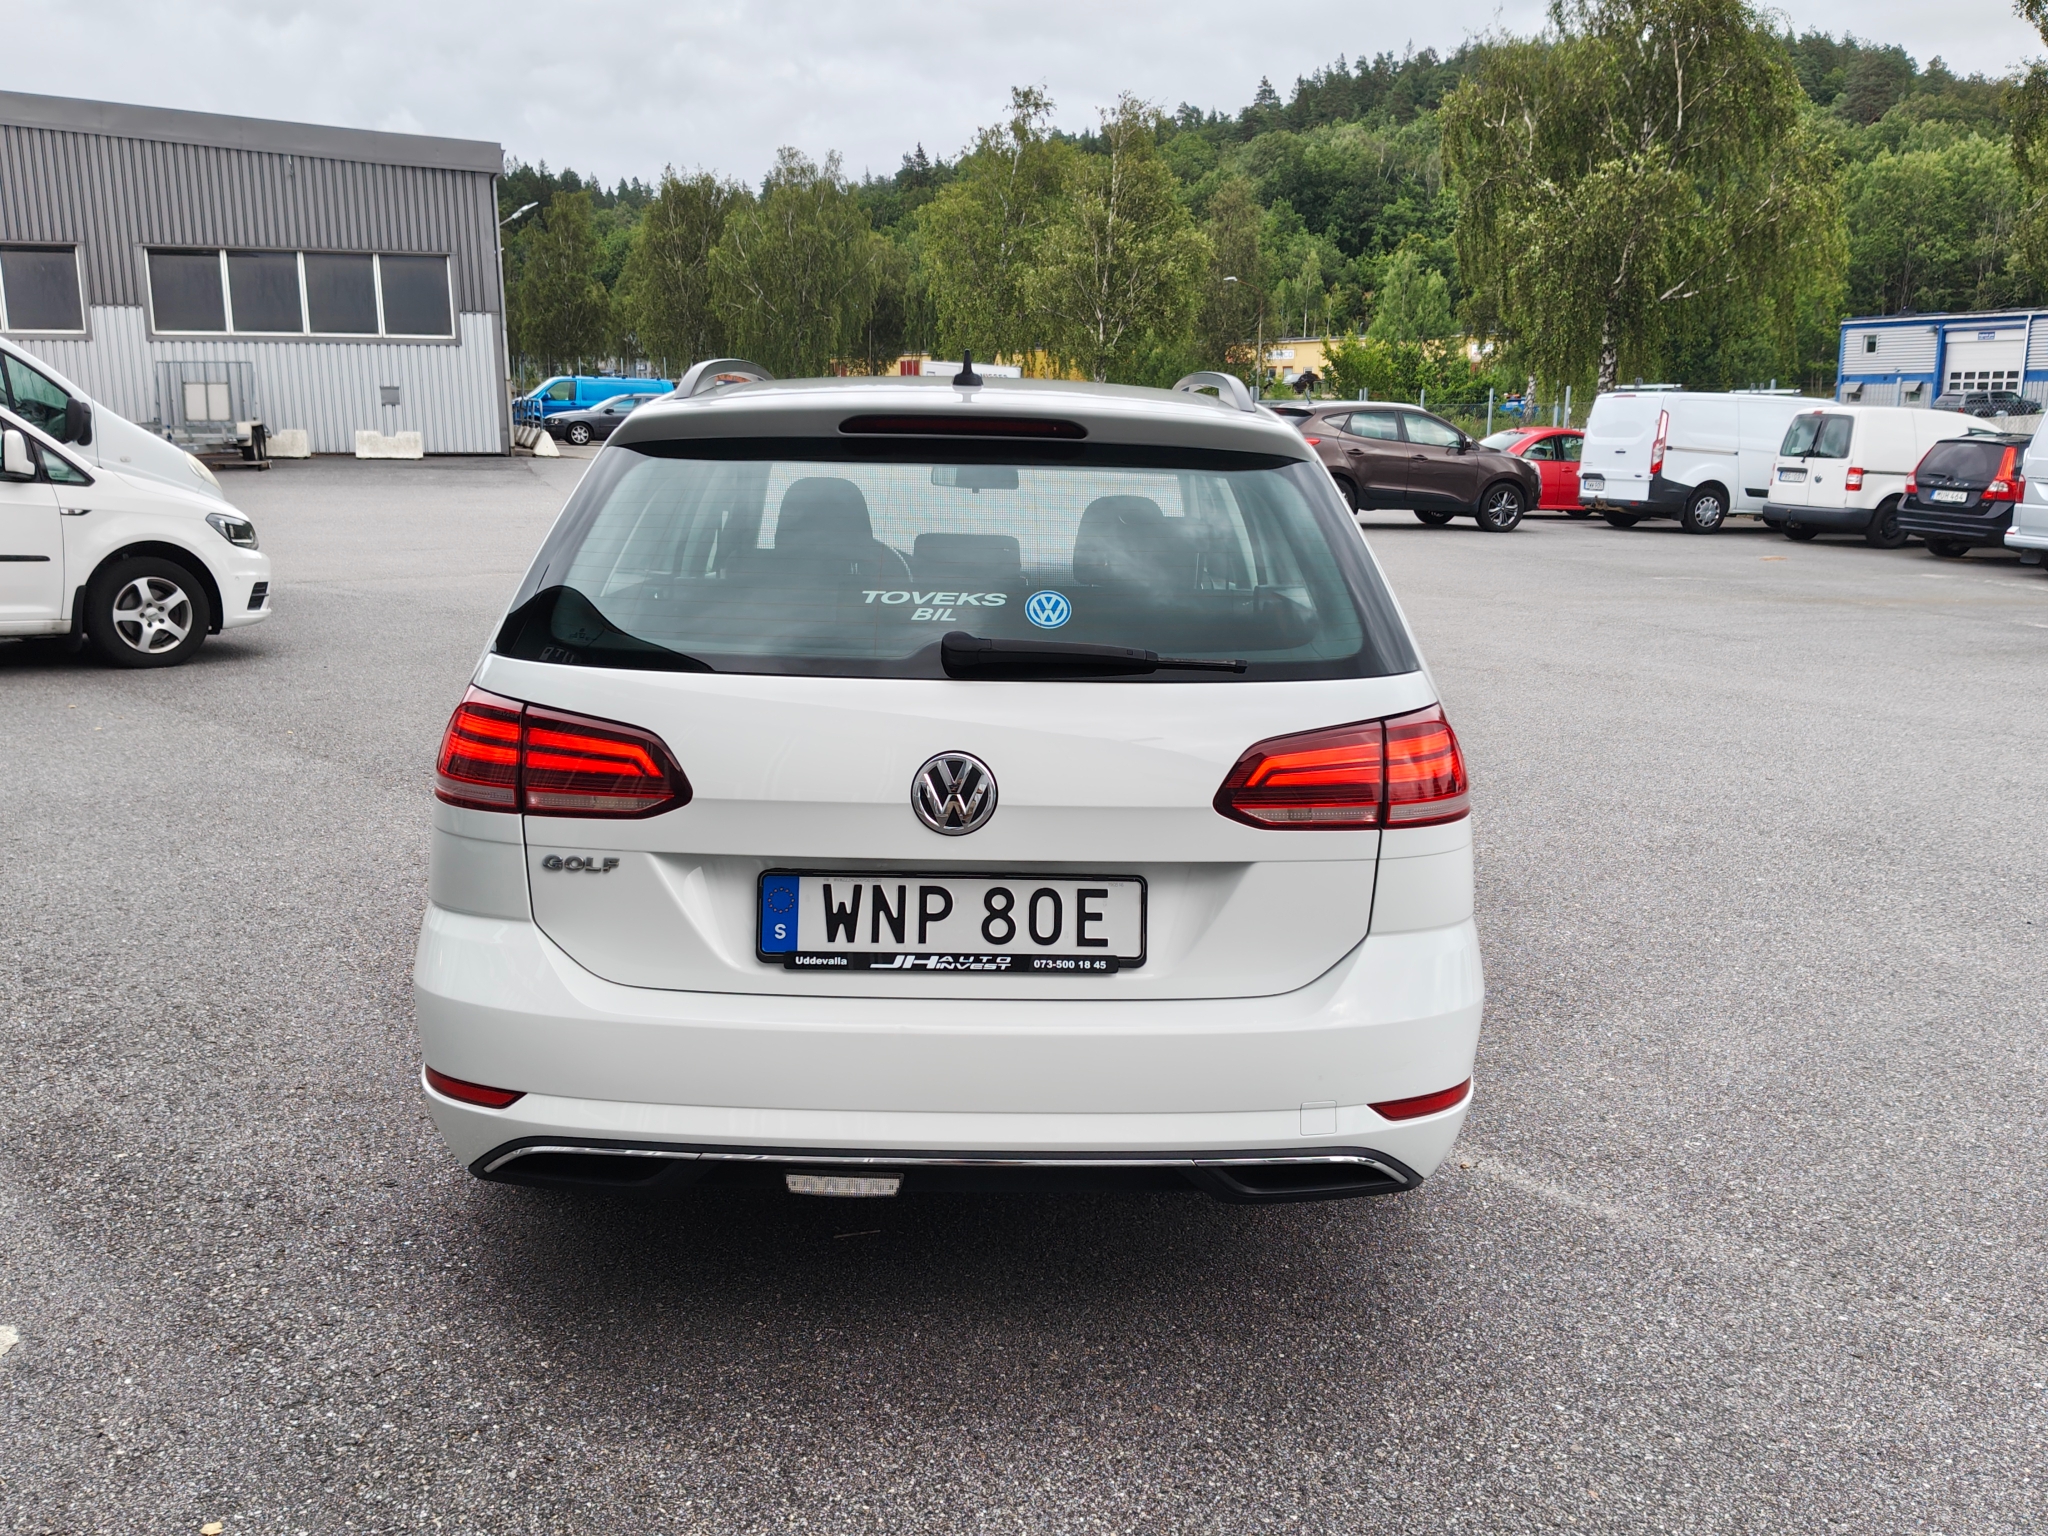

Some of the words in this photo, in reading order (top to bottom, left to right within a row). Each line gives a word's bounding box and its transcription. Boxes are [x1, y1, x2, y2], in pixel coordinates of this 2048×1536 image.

[862, 590, 1008, 607] TOVEKS
[911, 608, 957, 622] BIL
[541, 854, 620, 873] GOLF
[823, 884, 953, 943] WNP
[981, 887, 1108, 946] 80E
[774, 923, 787, 940] S
[795, 956, 848, 966] Uddevalla
[1033, 959, 1075, 970] 073-500
[1078, 960, 1091, 970] 18
[1093, 960, 1107, 970] 45
